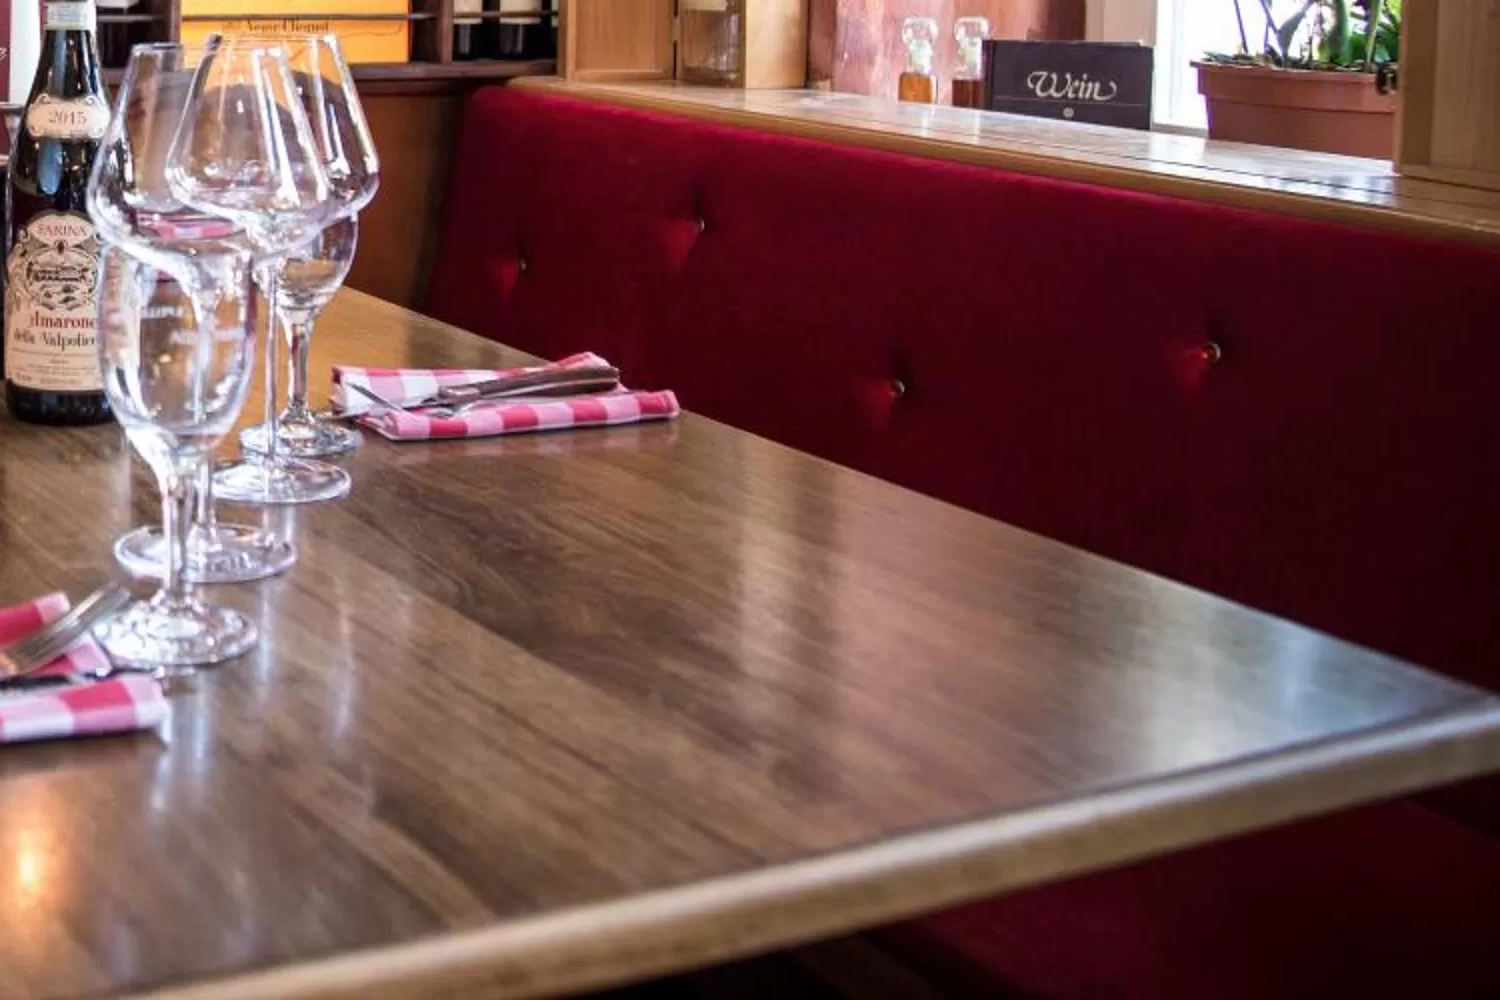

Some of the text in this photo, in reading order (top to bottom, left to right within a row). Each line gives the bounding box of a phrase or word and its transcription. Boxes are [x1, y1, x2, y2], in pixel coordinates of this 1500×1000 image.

[1027, 71, 1117, 101] Wein
[48, 110, 87, 125] 2015
[37, 223, 87, 237] FARINA
